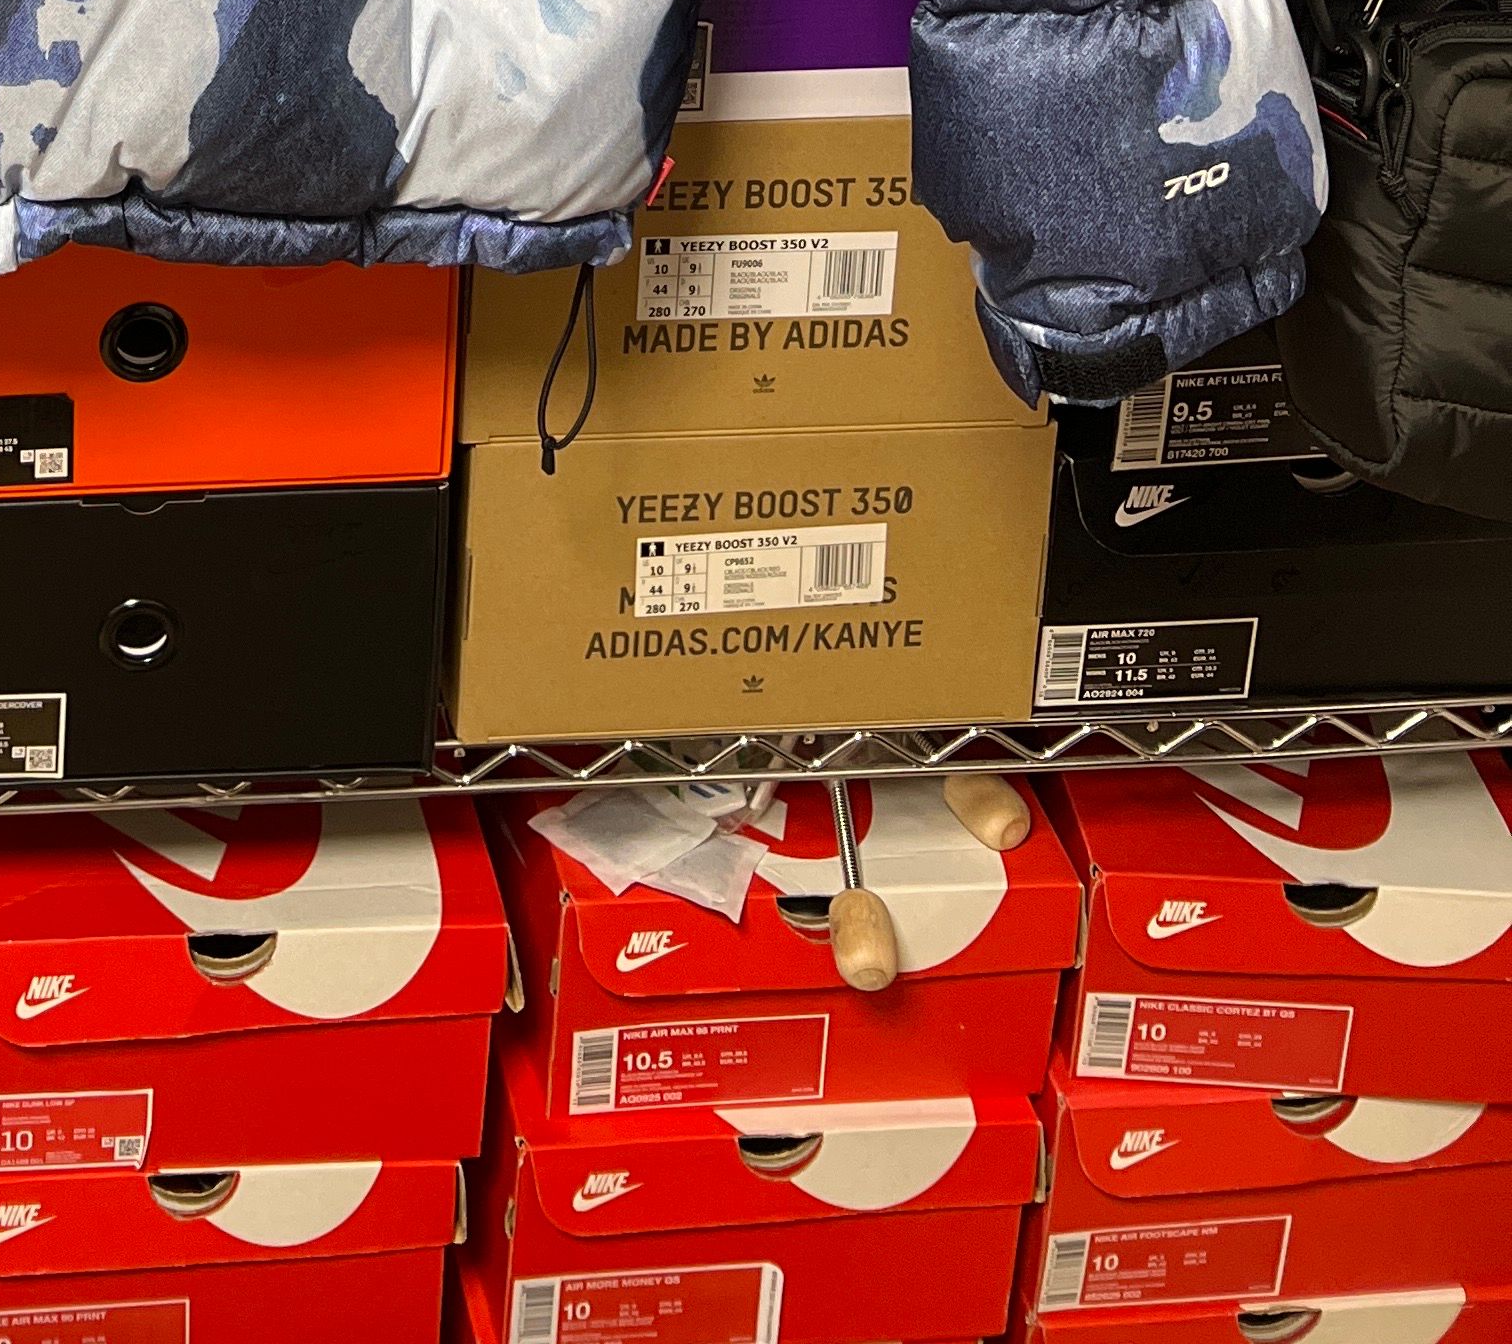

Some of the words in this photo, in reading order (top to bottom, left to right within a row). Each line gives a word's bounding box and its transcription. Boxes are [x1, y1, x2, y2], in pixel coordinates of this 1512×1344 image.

[1164, 161, 1230, 201] 700
[744, 178, 857, 210] BOOST
[680, 240, 725, 252] YEEZY
[729, 239, 778, 251] BOOST
[780, 239, 808, 250] 350
[810, 238, 830, 249] V2
[654, 263, 669, 275] 10
[652, 284, 669, 296] 44
[648, 305, 671, 318] 280
[682, 305, 706, 317] 270
[622, 320, 720, 355] MADE
[729, 320, 775, 352] BY
[782, 318, 910, 350] ADIDAS
[1176, 376, 1204, 389] NIKE
[1230, 373, 1269, 386] ULTRA
[1172, 400, 1214, 424] 9.5
[1208, 446, 1229, 458] 700
[616, 492, 724, 525] YEEZY
[734, 489, 843, 520] BOOST
[851, 486, 914, 516] 350
[1126, 484, 1175, 509] NIKE
[675, 540, 712, 554] YEEZY
[714, 538, 755, 551] BOOST
[757, 536, 780, 548] 350
[782, 535, 799, 547] V2
[650, 564, 665, 577] 10
[649, 584, 664, 595] 44
[645, 603, 667, 615] 280
[679, 601, 701, 613] 270
[585, 619, 924, 661] ADIDAS.COM/KANYE
[1090, 629, 1109, 640] AIR
[1110, 629, 1137, 639] MAX
[1117, 652, 1137, 666] 10
[1115, 668, 1149, 682] 11.5
[1158, 900, 1208, 923] NIKE
[625, 930, 674, 955] NIKE
[26, 974, 75, 1000] NIKE
[1137, 1023, 1167, 1041] 10
[623, 1050, 673, 1072] 10.5
[0, 1130, 35, 1153] 10
[1119, 1129, 1165, 1152] NIKE
[582, 1171, 630, 1195] NIKE
[1093, 1253, 1120, 1272] 10
[563, 1302, 591, 1322] 10
